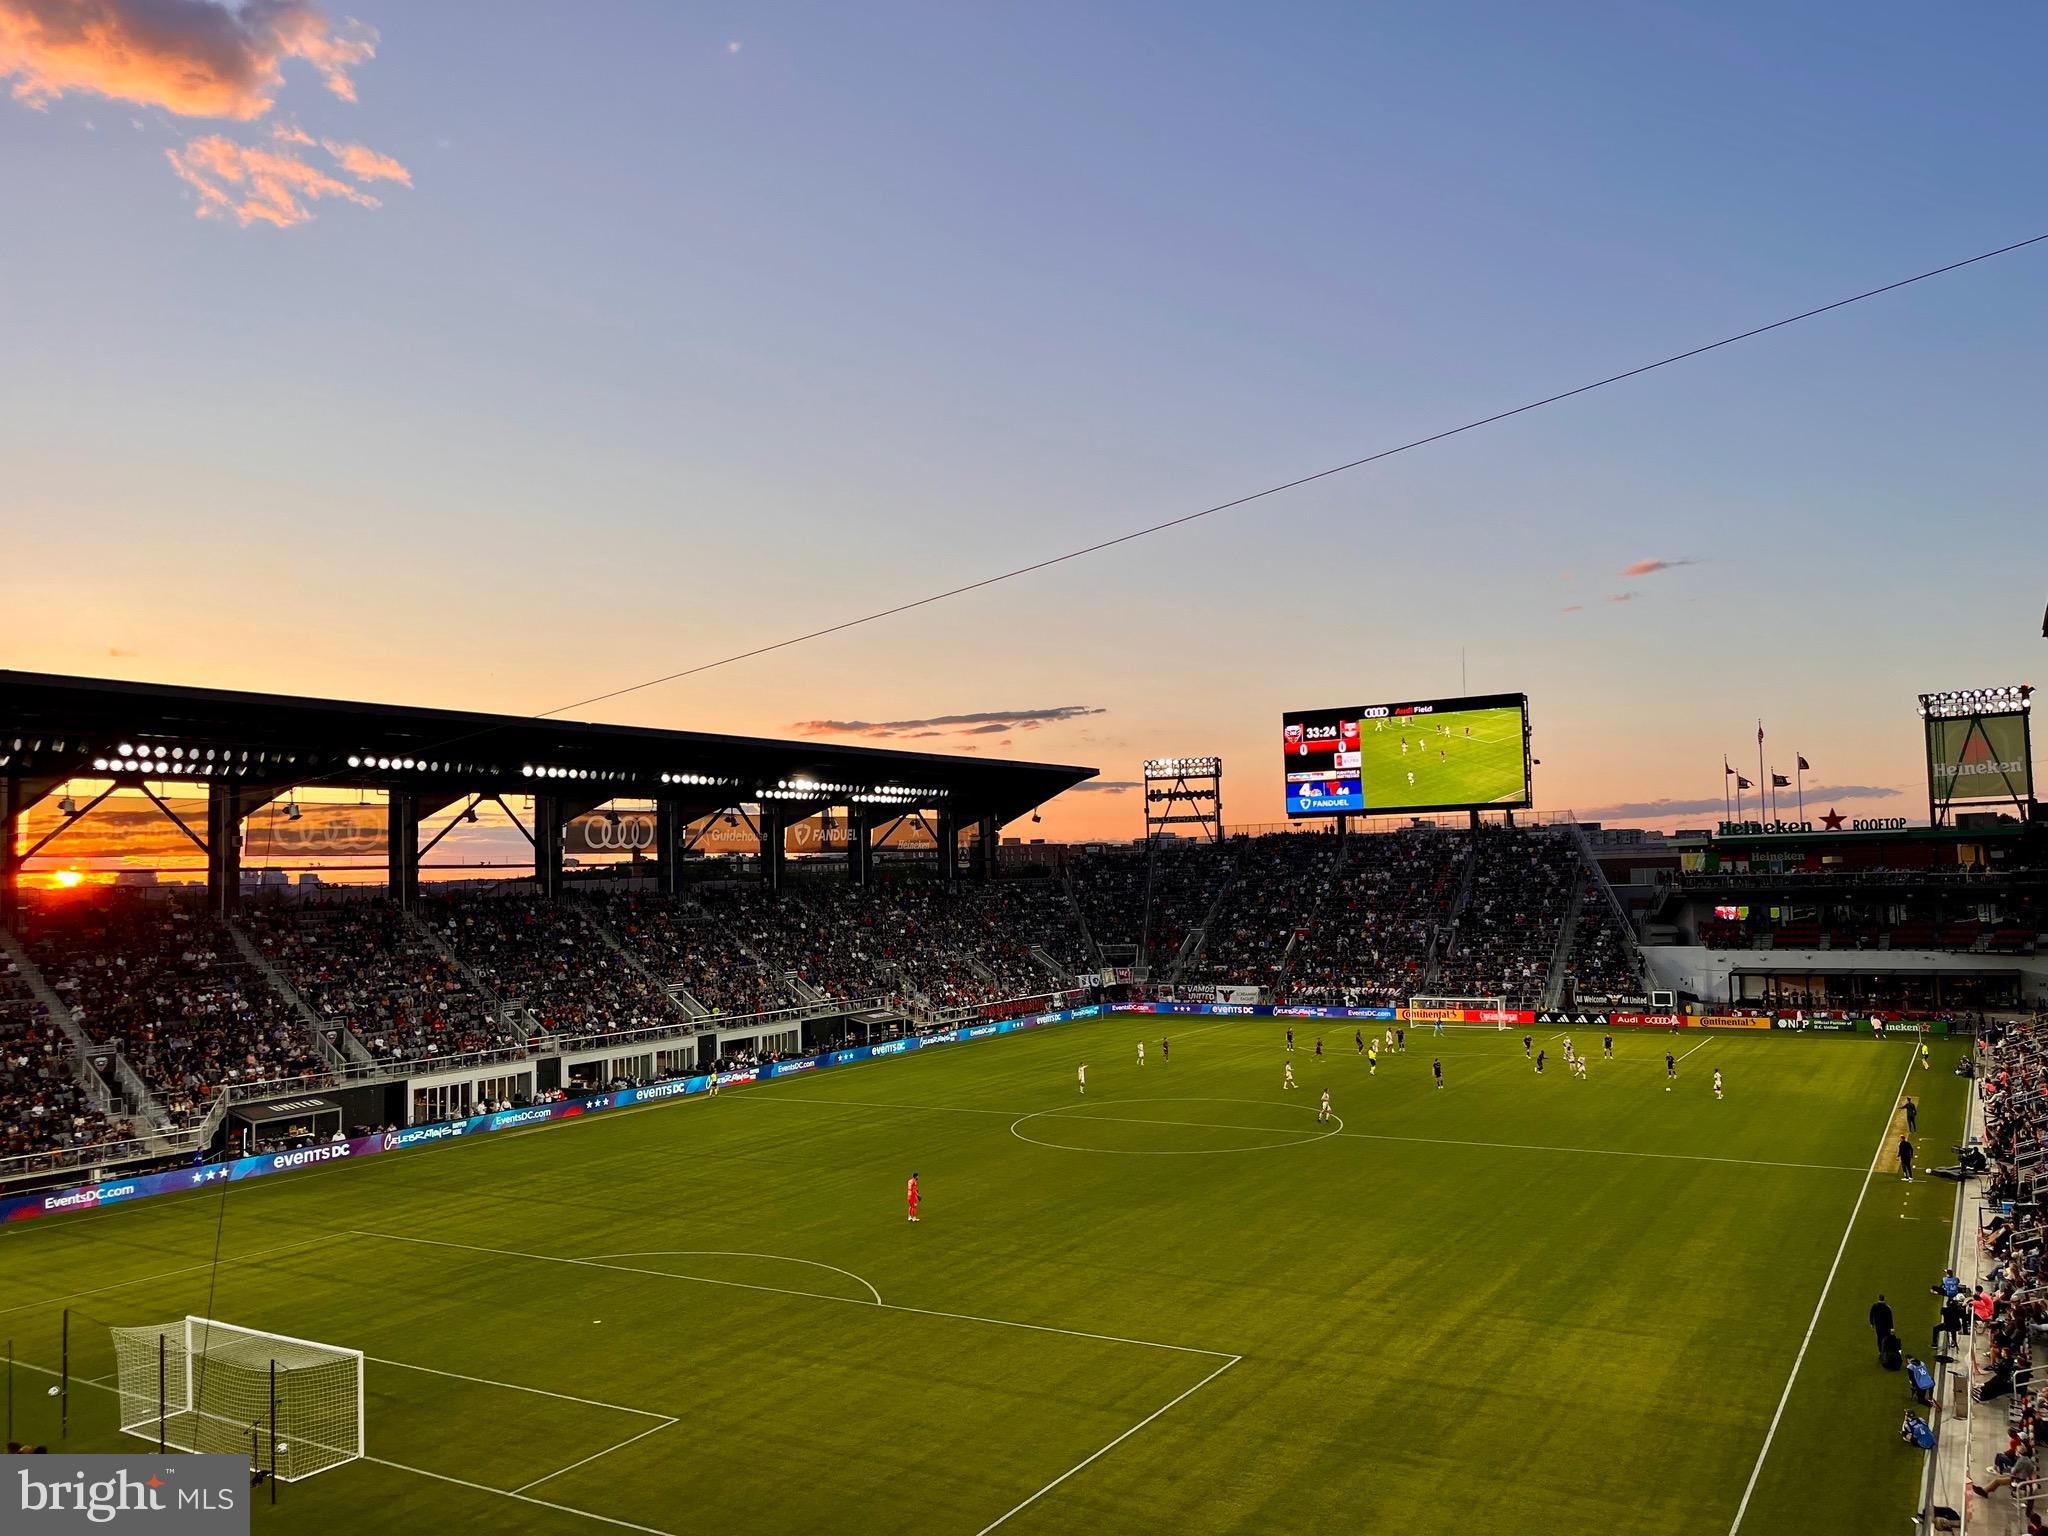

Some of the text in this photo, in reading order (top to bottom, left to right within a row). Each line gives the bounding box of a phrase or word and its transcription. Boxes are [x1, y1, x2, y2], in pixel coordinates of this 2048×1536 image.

[1414, 705, 1433, 713] Field
[1306, 726, 1337, 739] 33:24
[1300, 744, 1308, 756] 0
[1338, 741, 1346, 753] 0
[1933, 759, 2022, 777] Heineken
[1312, 799, 1350, 808] FANDUEL
[1717, 818, 1812, 836] Heineken
[1853, 817, 1906, 831] ROOFTOP
[711, 829, 768, 842] Guidehouse
[812, 828, 858, 842] FANDUEL
[1752, 852, 1805, 862] Heineken
[1584, 995, 1607, 1004] Welcome
[1629, 995, 1647, 1004] United
[1402, 1009, 1449, 1020] Continental
[1700, 1016, 1749, 1027] Continental
[1884, 1023, 1918, 1032] ineken
[268, 1099, 324, 1112] UNITED
[496, 1109, 551, 1126] EventsDC.com
[332, 1144, 350, 1158] DC
[45, 1184, 134, 1210] EventsDC.com
